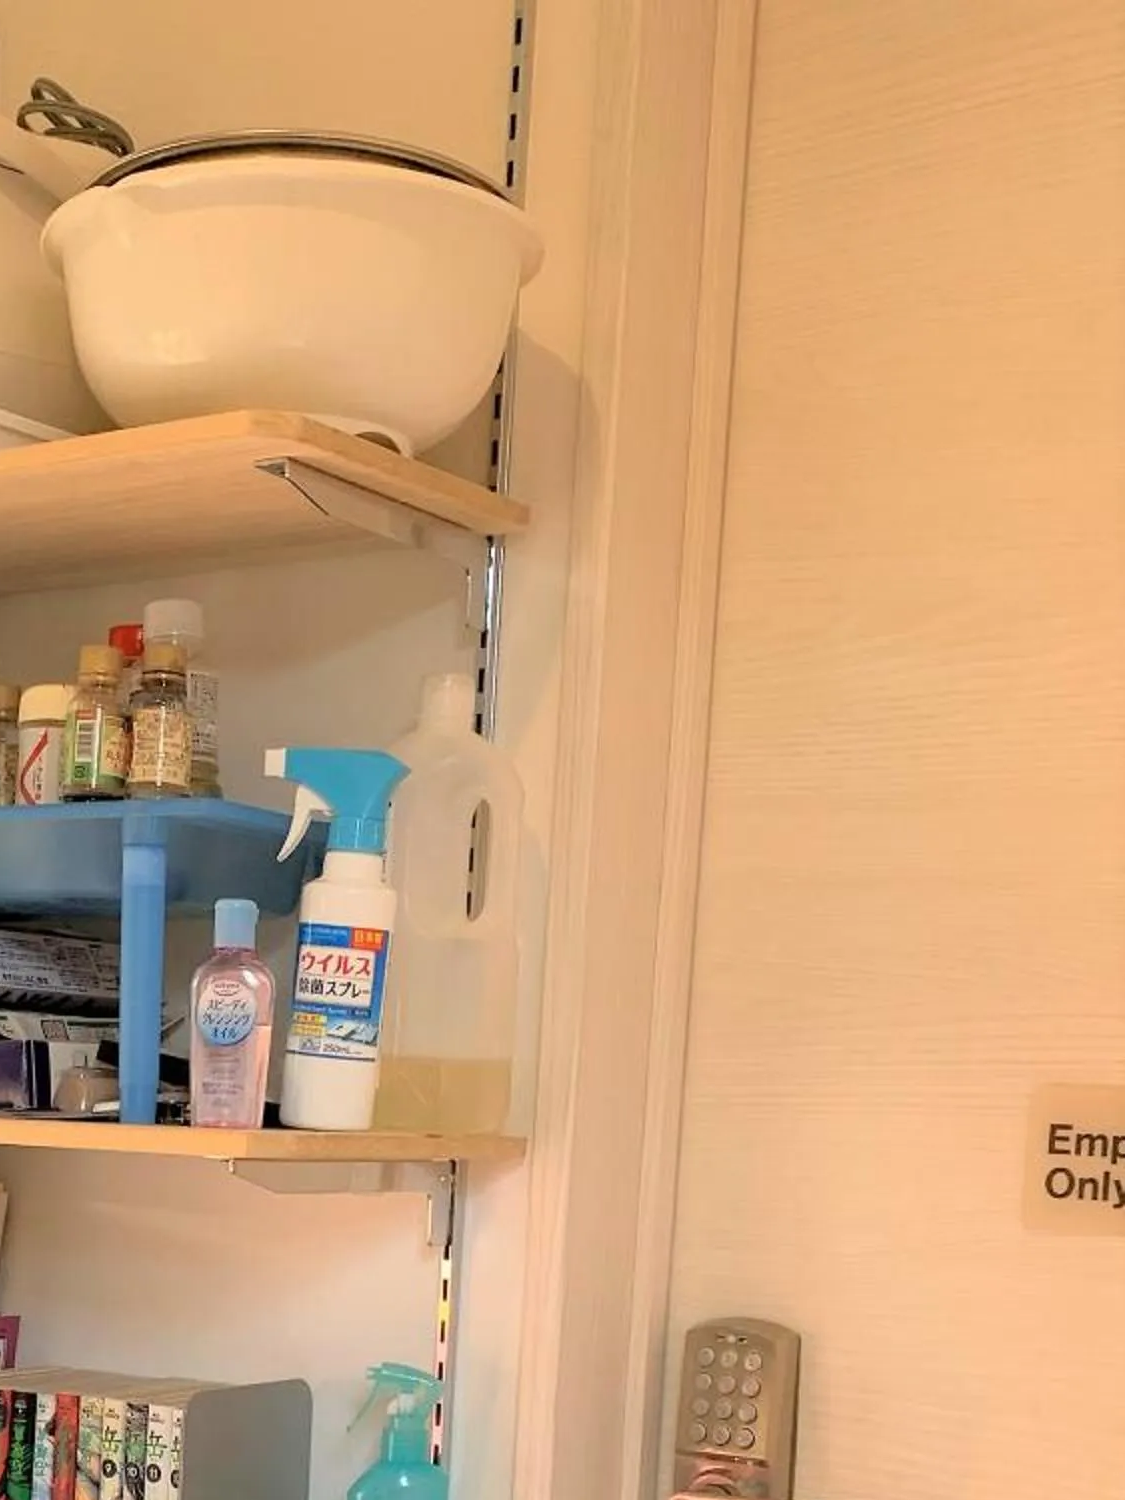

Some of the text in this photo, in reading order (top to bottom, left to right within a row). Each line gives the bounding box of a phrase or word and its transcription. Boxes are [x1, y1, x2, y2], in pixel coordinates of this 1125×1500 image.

[301, 951, 371, 977] ウイルス
[297, 977, 371, 999] 除菌スプレー
[1044, 1166, 1125, 1209] Only
